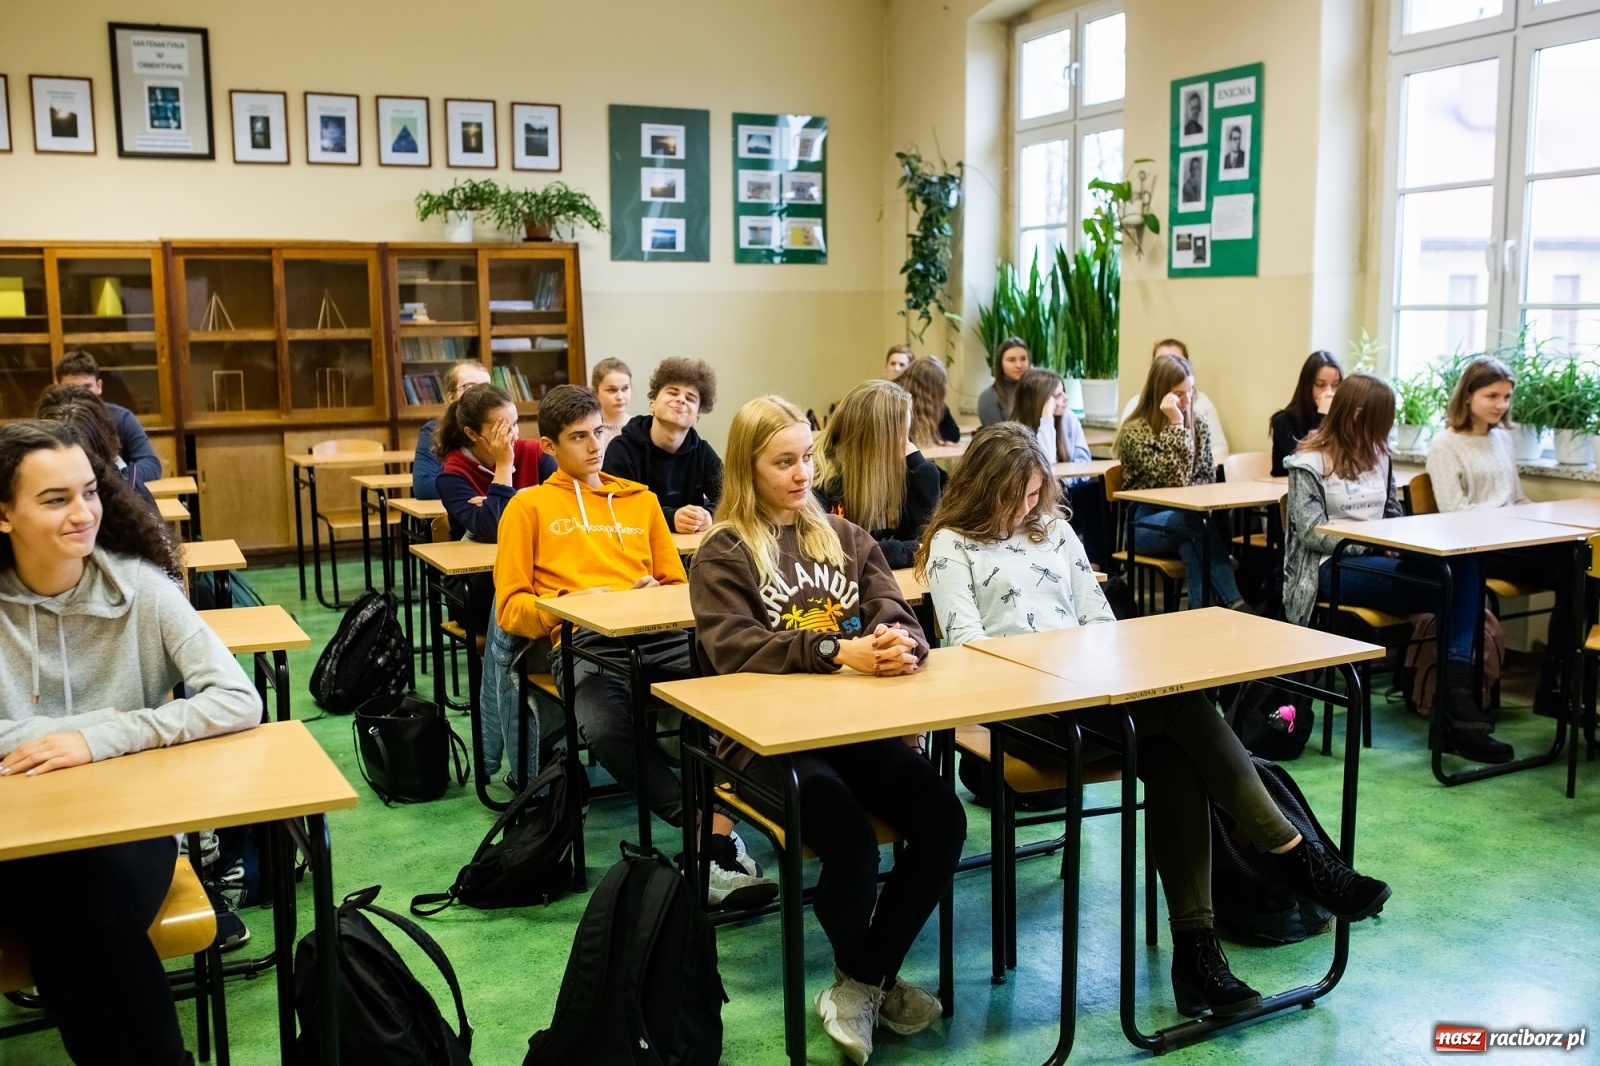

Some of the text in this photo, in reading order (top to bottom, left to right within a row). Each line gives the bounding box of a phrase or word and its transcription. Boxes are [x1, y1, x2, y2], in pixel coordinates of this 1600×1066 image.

[1218, 86, 1251, 99] ENIGMA
[550, 517, 645, 538] Champion
[842, 616, 861, 634] 59
